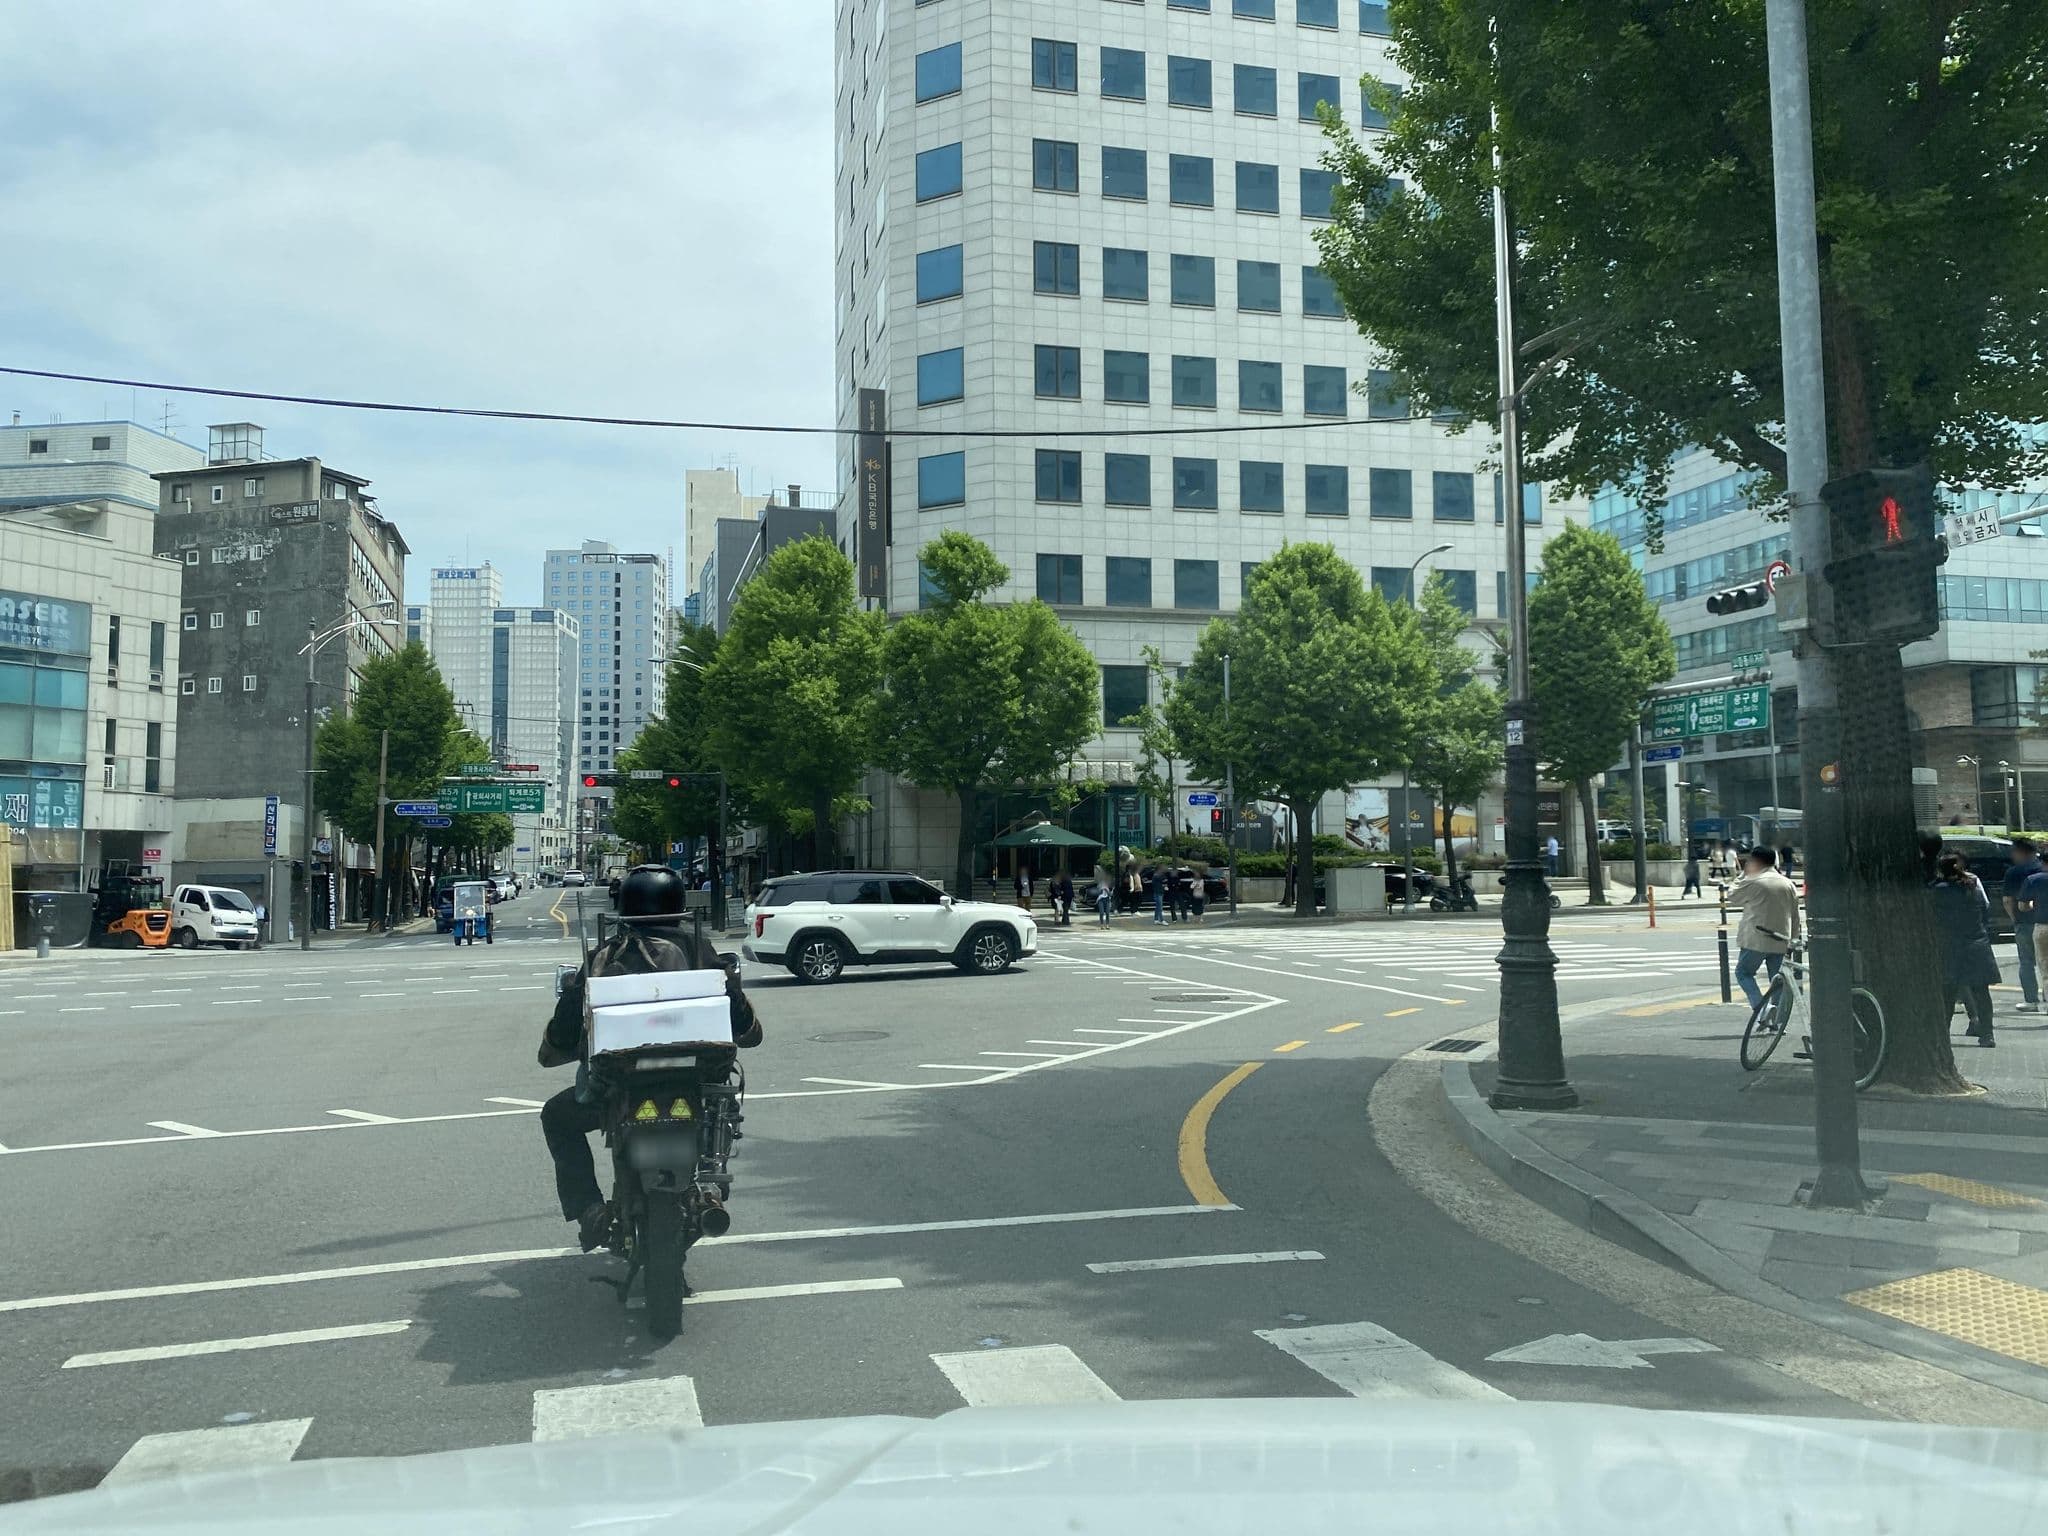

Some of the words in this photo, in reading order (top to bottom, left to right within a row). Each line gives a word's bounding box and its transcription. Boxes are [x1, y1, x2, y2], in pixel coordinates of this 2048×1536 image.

[868, 473, 877, 530] KB국민은행
[1734, 692, 1759, 705] 중구청
[509, 788, 540, 796] 퇴계로5가
[34, 804, 79, 817] MDF
[265, 805, 276, 848] 신라간판
